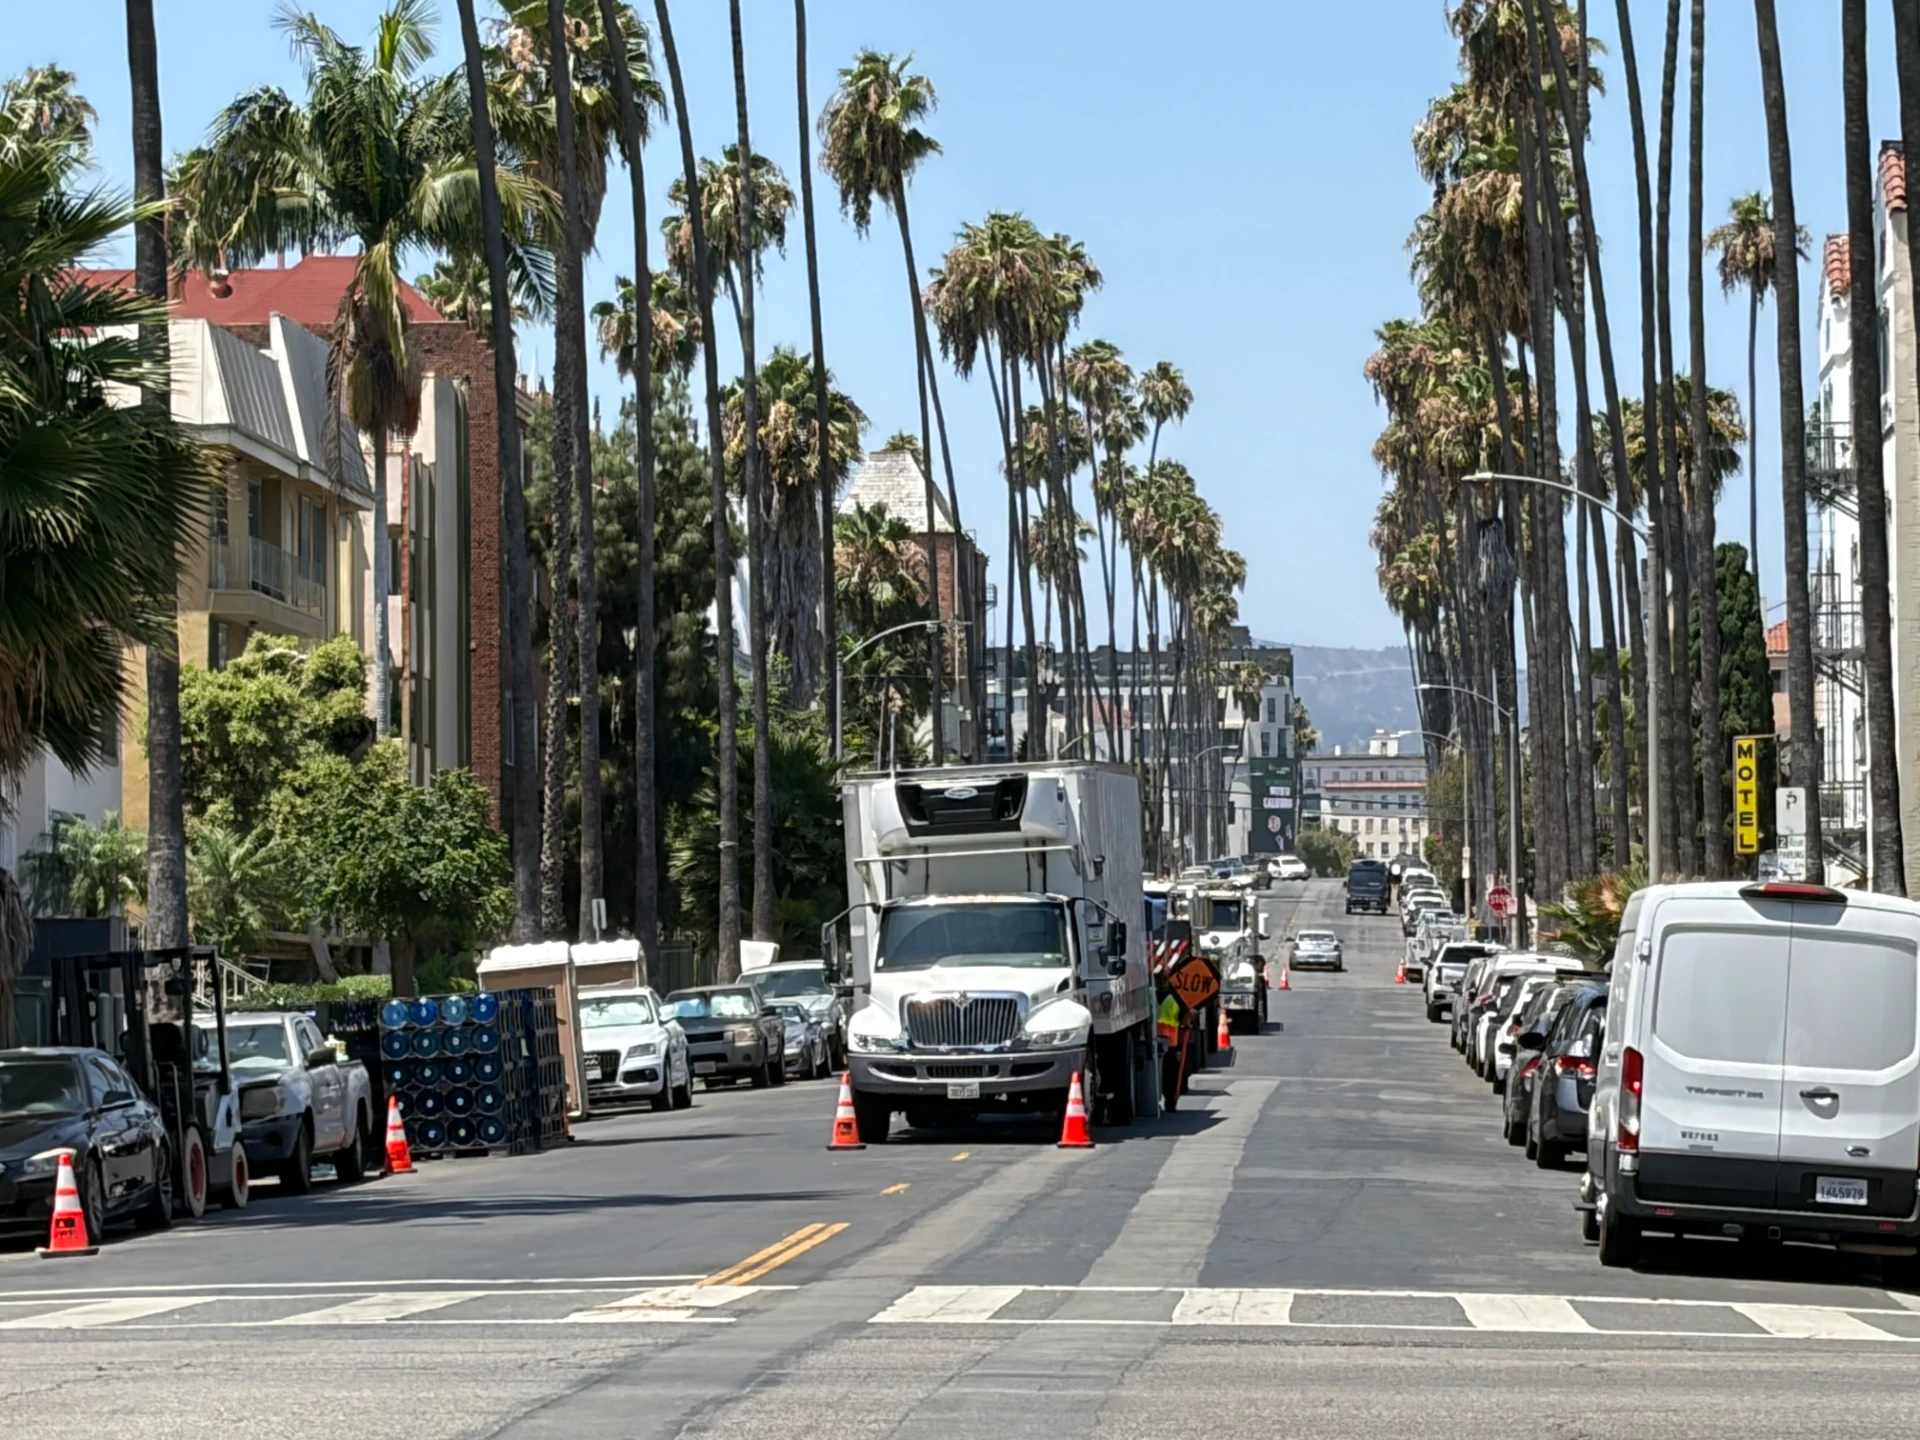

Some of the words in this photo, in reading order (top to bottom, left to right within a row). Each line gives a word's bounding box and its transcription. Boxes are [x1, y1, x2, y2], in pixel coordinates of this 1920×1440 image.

[1737, 743, 1755, 849] MOTEL
[1779, 837, 1787, 848] 2
[1174, 971, 1213, 993] SLOW
